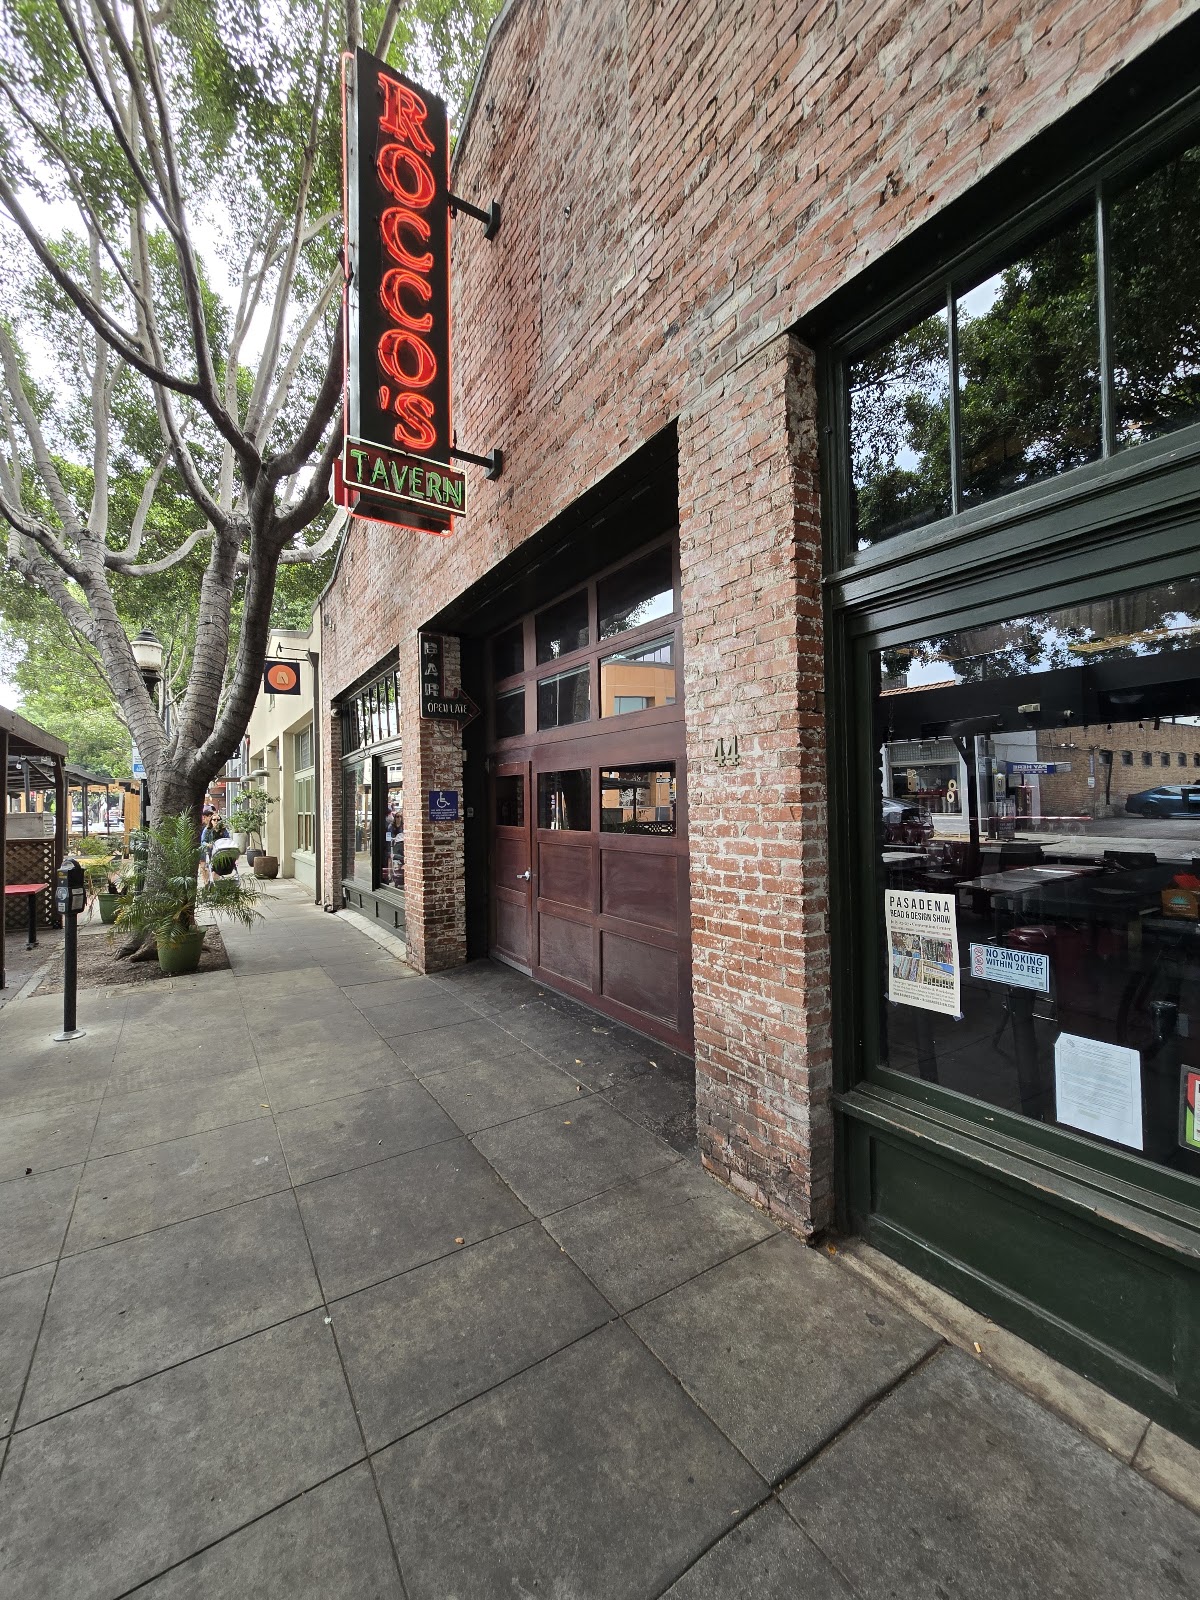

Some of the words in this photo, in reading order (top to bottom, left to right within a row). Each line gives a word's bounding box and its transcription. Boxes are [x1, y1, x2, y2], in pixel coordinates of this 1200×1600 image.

[377, 71, 438, 450] ROCCO'S
[350, 449, 464, 508] TAVERN
[423, 641, 440, 697] BAR
[427, 702, 449, 714] OPEN
[450, 703, 468, 714] LATE
[712, 734, 741, 768] 44
[889, 896, 950, 913] PASADENA
[905, 911, 910, 919] &
[910, 911, 932, 922] DESIGN
[932, 914, 951, 924] SHOW
[985, 957, 1013, 970] WITHIN
[1015, 963, 1025, 972] 20
[1026, 965, 1044, 975] FEET
[986, 948, 999, 958] NO
[1000, 951, 1044, 967] SMOKING
